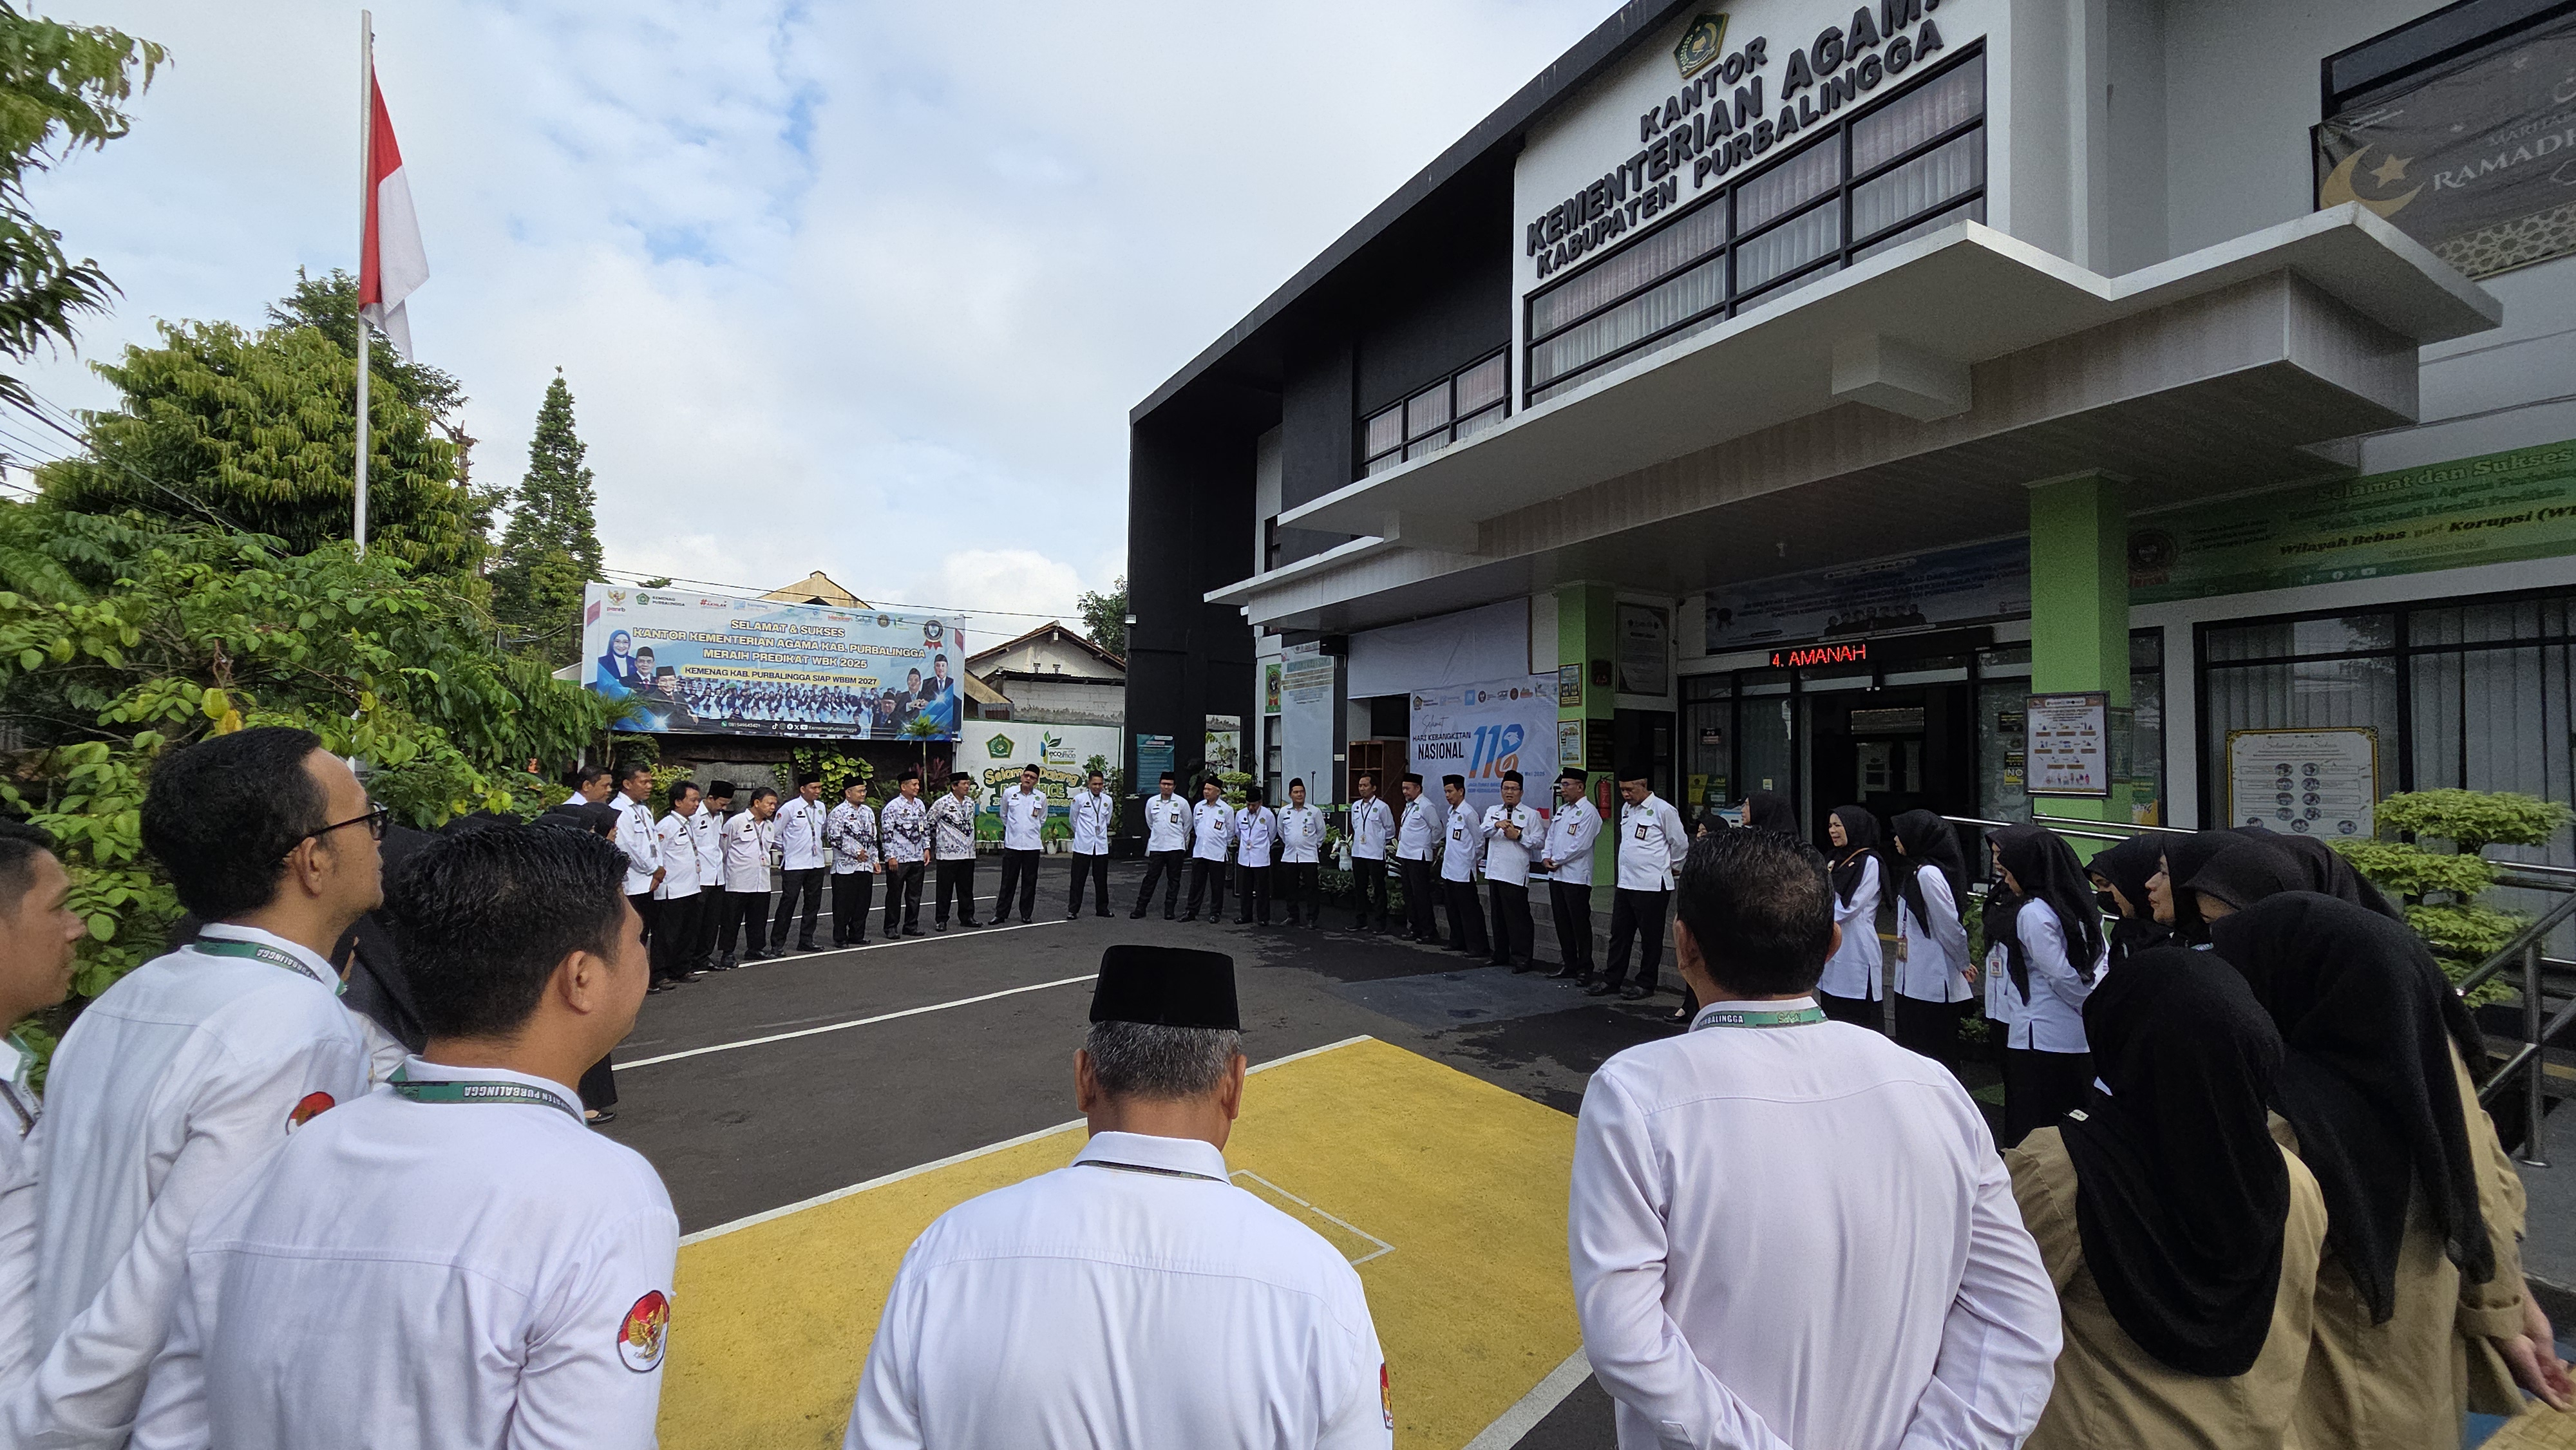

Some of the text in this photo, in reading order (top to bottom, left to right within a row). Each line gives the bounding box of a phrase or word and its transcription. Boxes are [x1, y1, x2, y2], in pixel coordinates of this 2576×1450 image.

[1640, 36, 1768, 142] KANTOR
[1526, 0, 1940, 258] KEMENTERIAN AGAM
[1537, 18, 1944, 279] KABUPATEN PURBALINGGA
[2315, 475, 2413, 502] Selamat
[2418, 467, 2467, 489] dan
[2474, 449, 2573, 476] Sukses
[2280, 537, 2348, 556] Wilayah
[2351, 531, 2407, 547] Bebas
[2448, 511, 2532, 533] Korupsi
[731, 619, 846, 637] SELAMAT & SUKSES
[633, 627, 926, 658] KANTOR KEMENTERIAN AGAMA KAB. PURBALINGGA
[703, 648, 868, 668] MERAIH PREDIKAT WBK 2025
[1772, 644, 1866, 668] 4. AMANAH
[685, 666, 729, 677] KEMENAG
[751, 670, 811, 682] PURBALINGGA
[858, 677, 877, 686] 2027
[1428, 731, 1472, 741] KEBANGKITAN
[1418, 742, 1464, 760] NASIONAL
[1468, 723, 1525, 779] 118
[985, 767, 1024, 784] Selam
[257, 948, 310, 975] PURBALINGGA
[464, 1086, 540, 1099] PURBALINGGA
